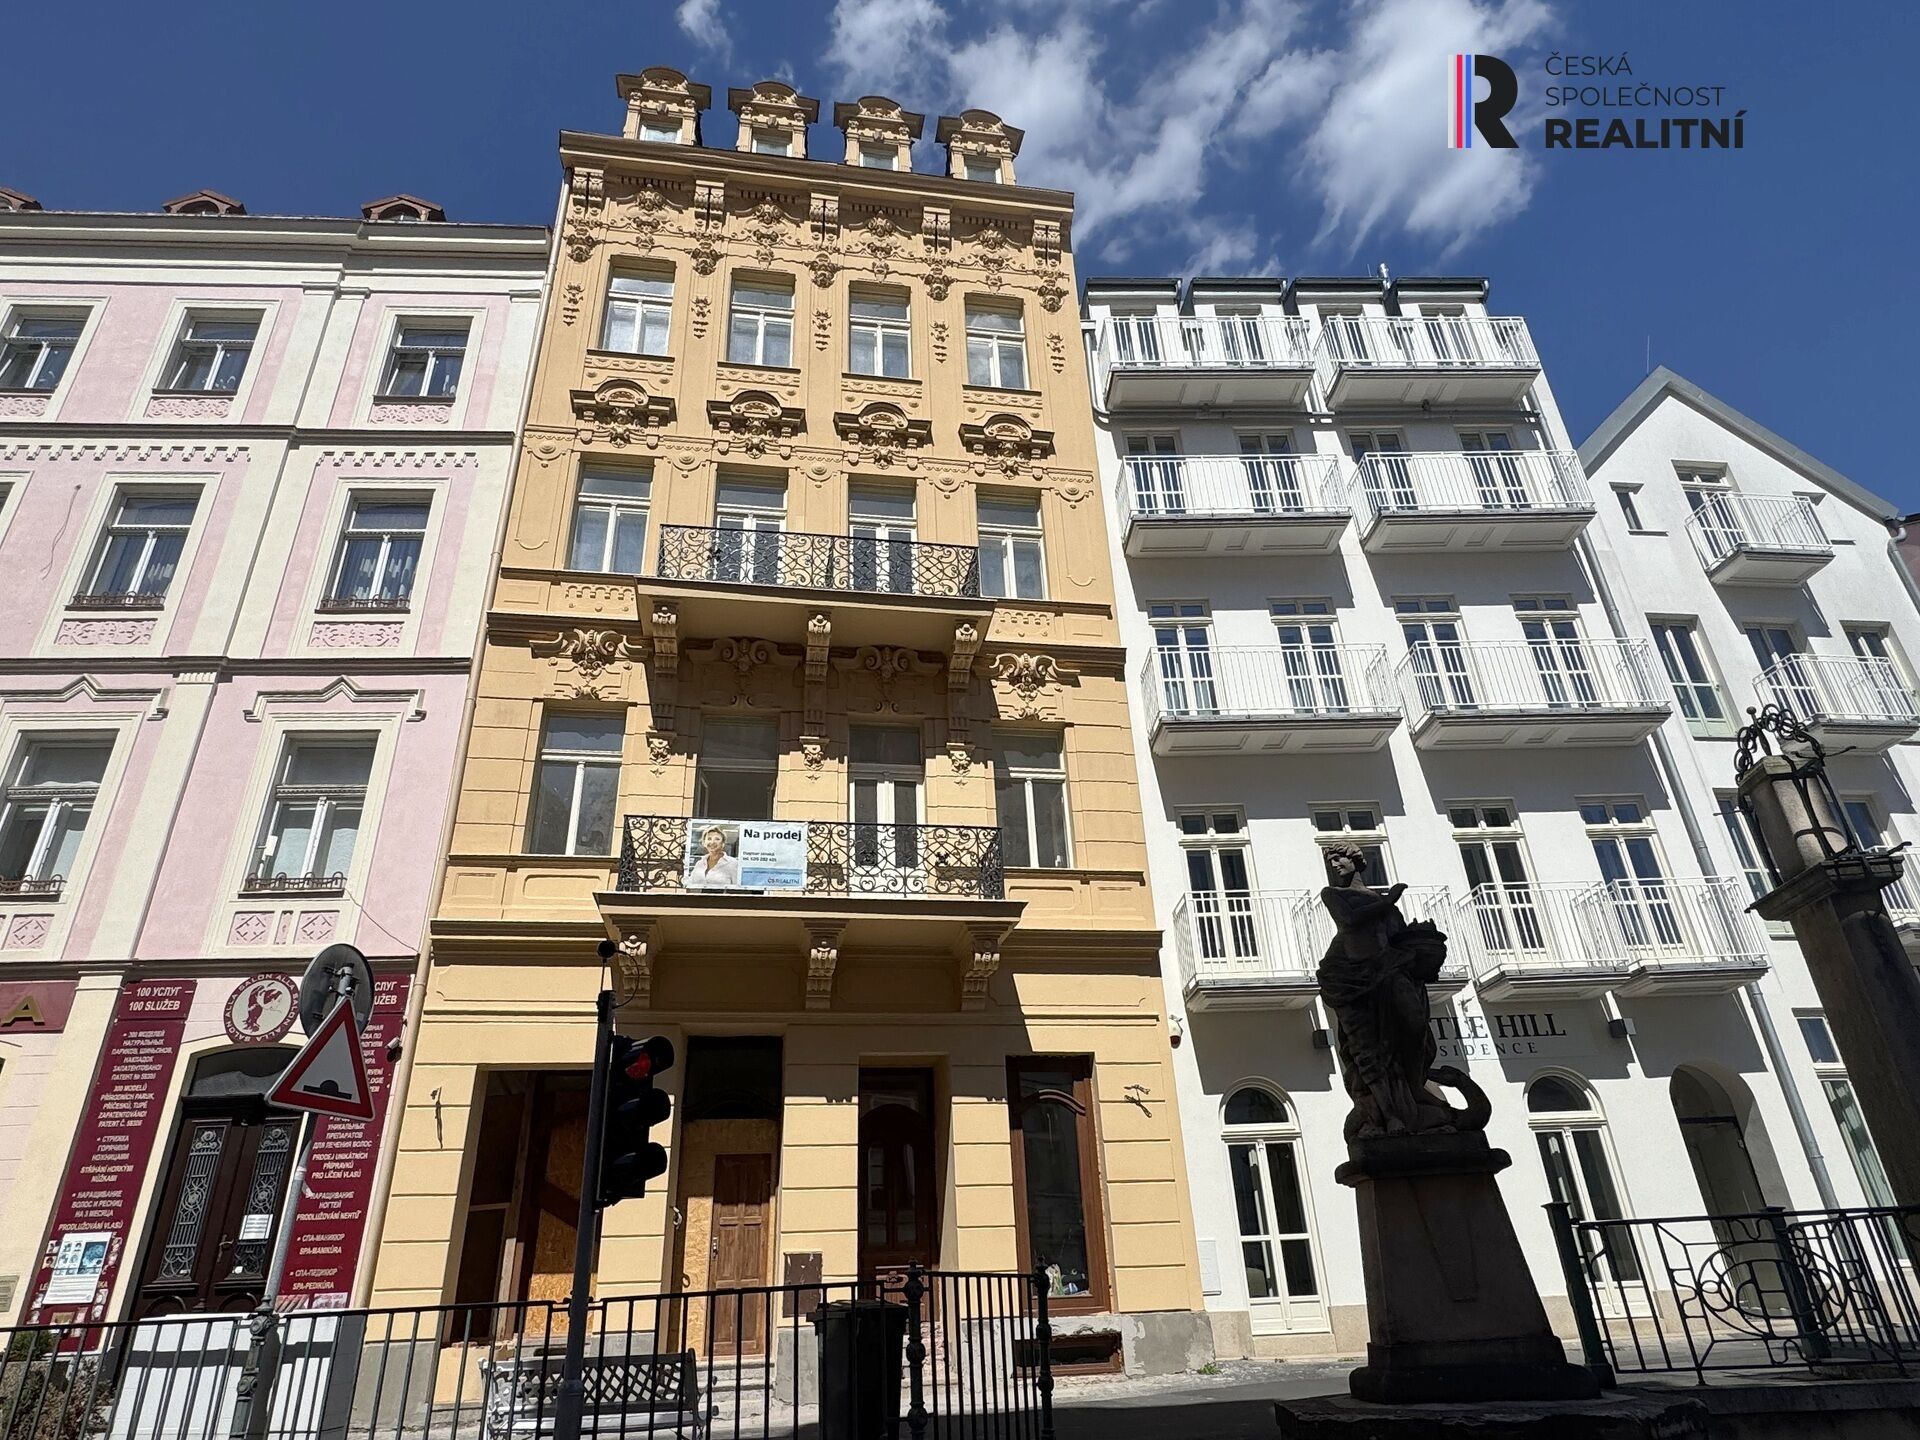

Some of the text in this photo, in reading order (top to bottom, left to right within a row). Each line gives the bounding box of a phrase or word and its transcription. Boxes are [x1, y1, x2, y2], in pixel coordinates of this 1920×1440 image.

[743, 829, 801, 842] Na prodej
[136, 986, 182, 997] 100 УСЛУГ
[374, 981, 397, 992] СЛУГ
[374, 994, 397, 1005] UŽEB
[129, 999, 180, 1011] 100 SLUŽEB
[225, 973, 299, 1042] SALON ALLA SALON ALLA SALON ALLA
[1494, 1013, 1567, 1038] HILL
[98, 1120, 119, 1128] PATENT
[327, 1123, 366, 1131] УНИКАЛЬНЫХ
[101, 1135, 129, 1143] СТРИЖКА
[326, 1131, 363, 1139] ПРЕПАРАТОВ
[352, 1140, 373, 1148] ВОЛОС
[312, 1153, 335, 1161] PRODEJ
[343, 1169, 361, 1178] VLASŮ
[77, 1190, 123, 1199] НАРАЩИВАНИЕ
[74, 1210, 84, 1218] НА
[296, 1210, 340, 1221] PRODLUŽOVÁNÍ
[57, 1221, 103, 1231] PRODLUŽOVÁNÍ
[299, 1244, 342, 1255] SPA-MANIKÚRA
[292, 1280, 334, 1290] SPA-PEDIKÚRA
